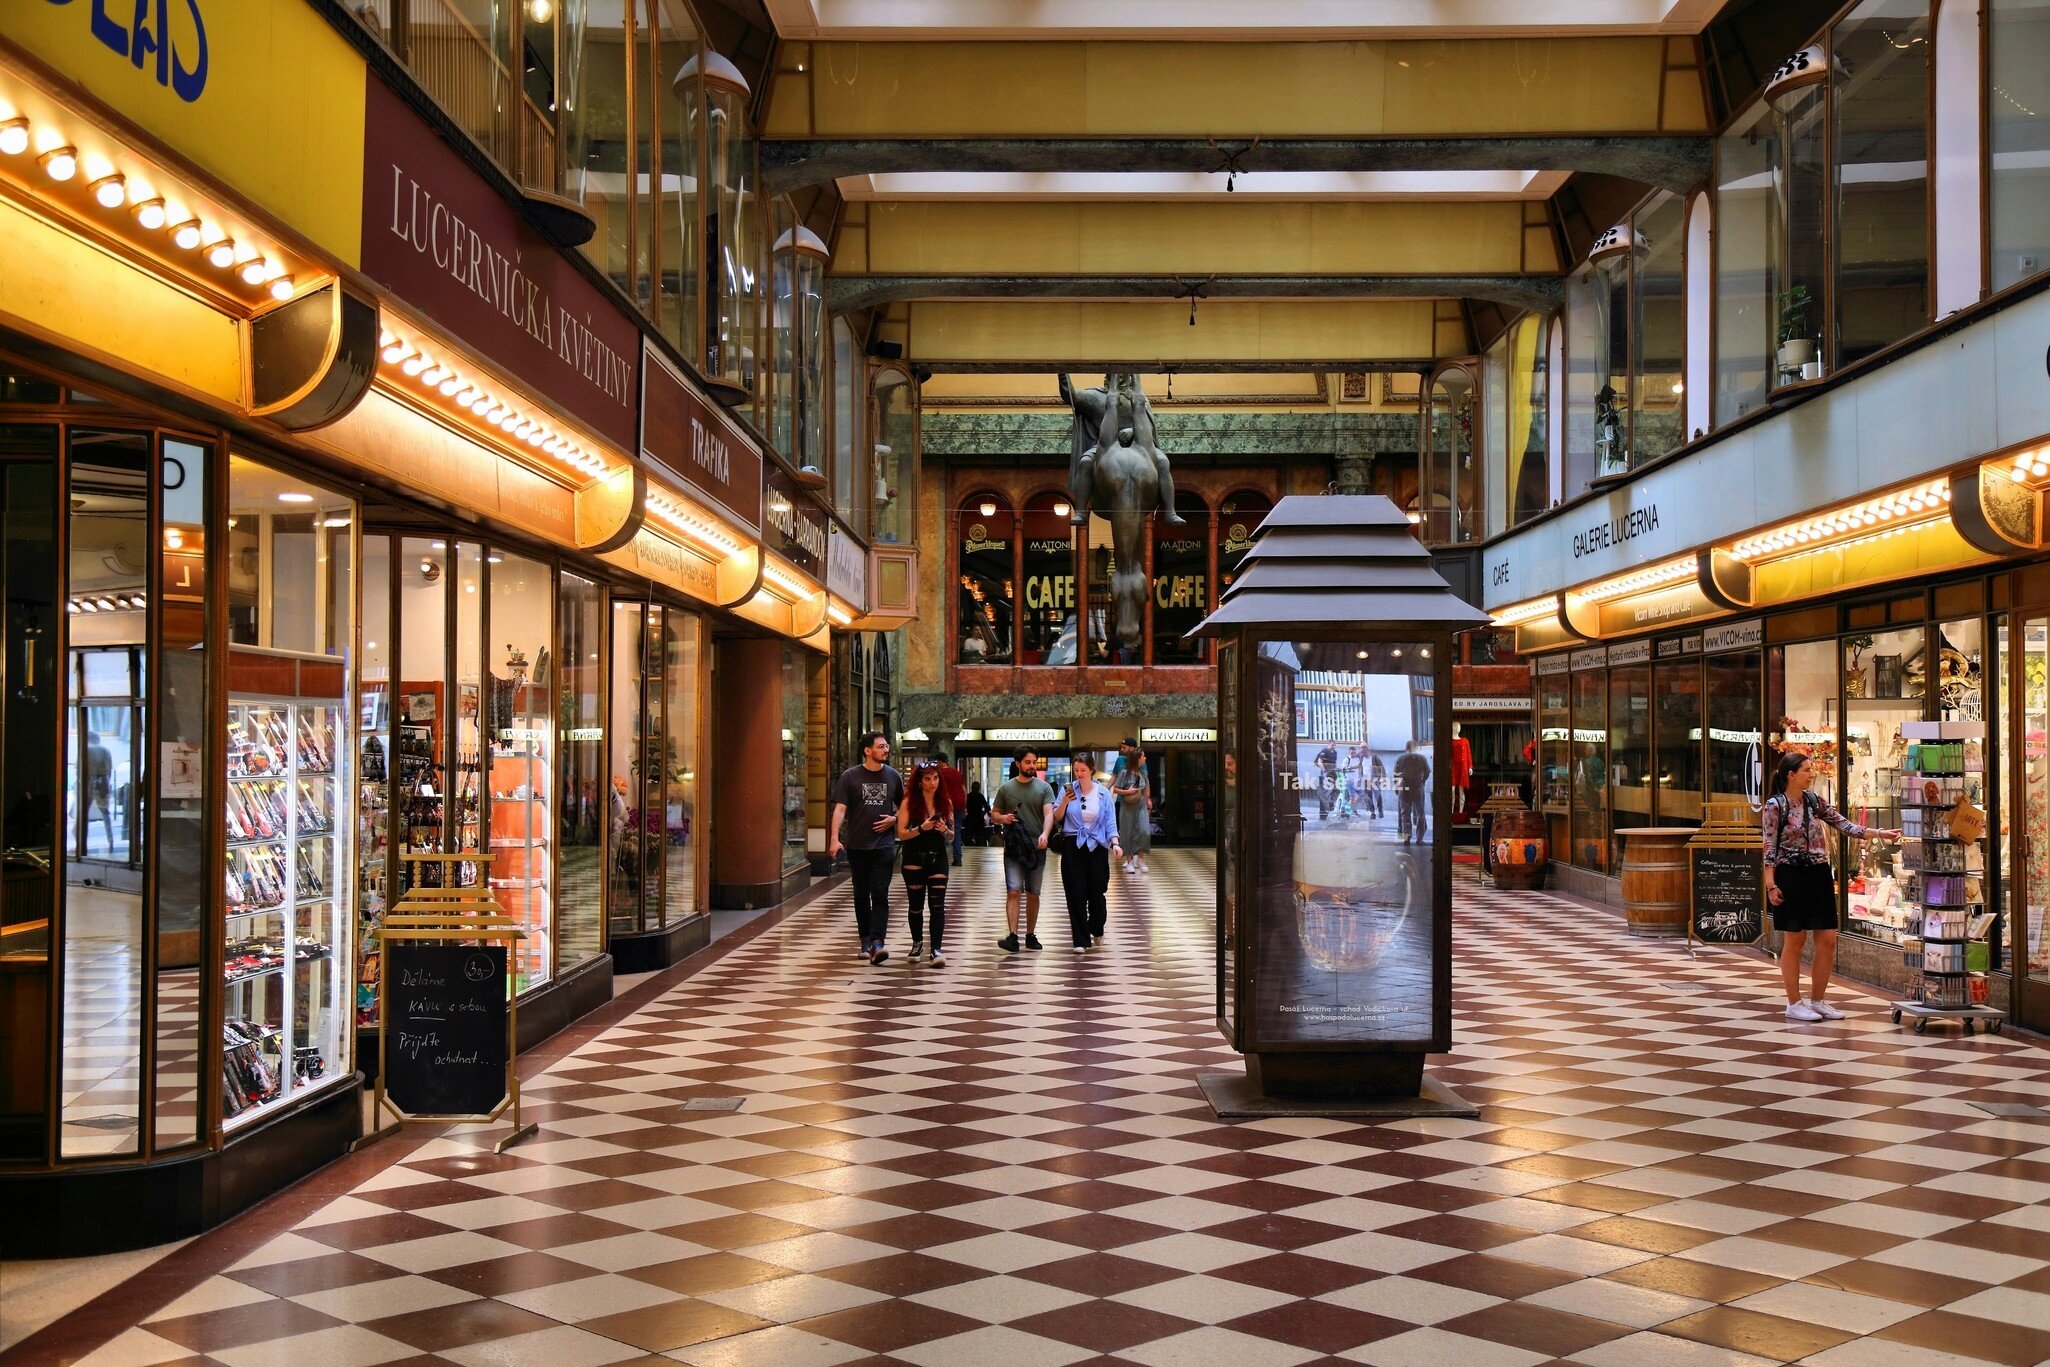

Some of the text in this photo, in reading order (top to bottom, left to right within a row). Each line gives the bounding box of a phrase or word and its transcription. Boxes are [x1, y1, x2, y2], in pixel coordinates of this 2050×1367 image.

[391, 164, 632, 408] LUCERNIČKA KVĚTINY
[691, 417, 729, 487] TRAFIKA
[766, 484, 794, 540] LUCERNA
[1030, 541, 1071, 550] MATTONI
[1573, 503, 1660, 558] GALERIE LUCERNA
[1493, 558, 1510, 587] CAFÉ
[1026, 575, 1075, 609] CAFE
[1156, 575, 1205, 609] CAFE
[1648, 602, 1659, 619] Wine
[1659, 600, 1671, 618] Shop
[1670, 601, 1680, 615] and
[1279, 770, 1318, 791] Tak
[1323, 776, 1347, 791] se
[1302, 1004, 1332, 1012] Lucerna
